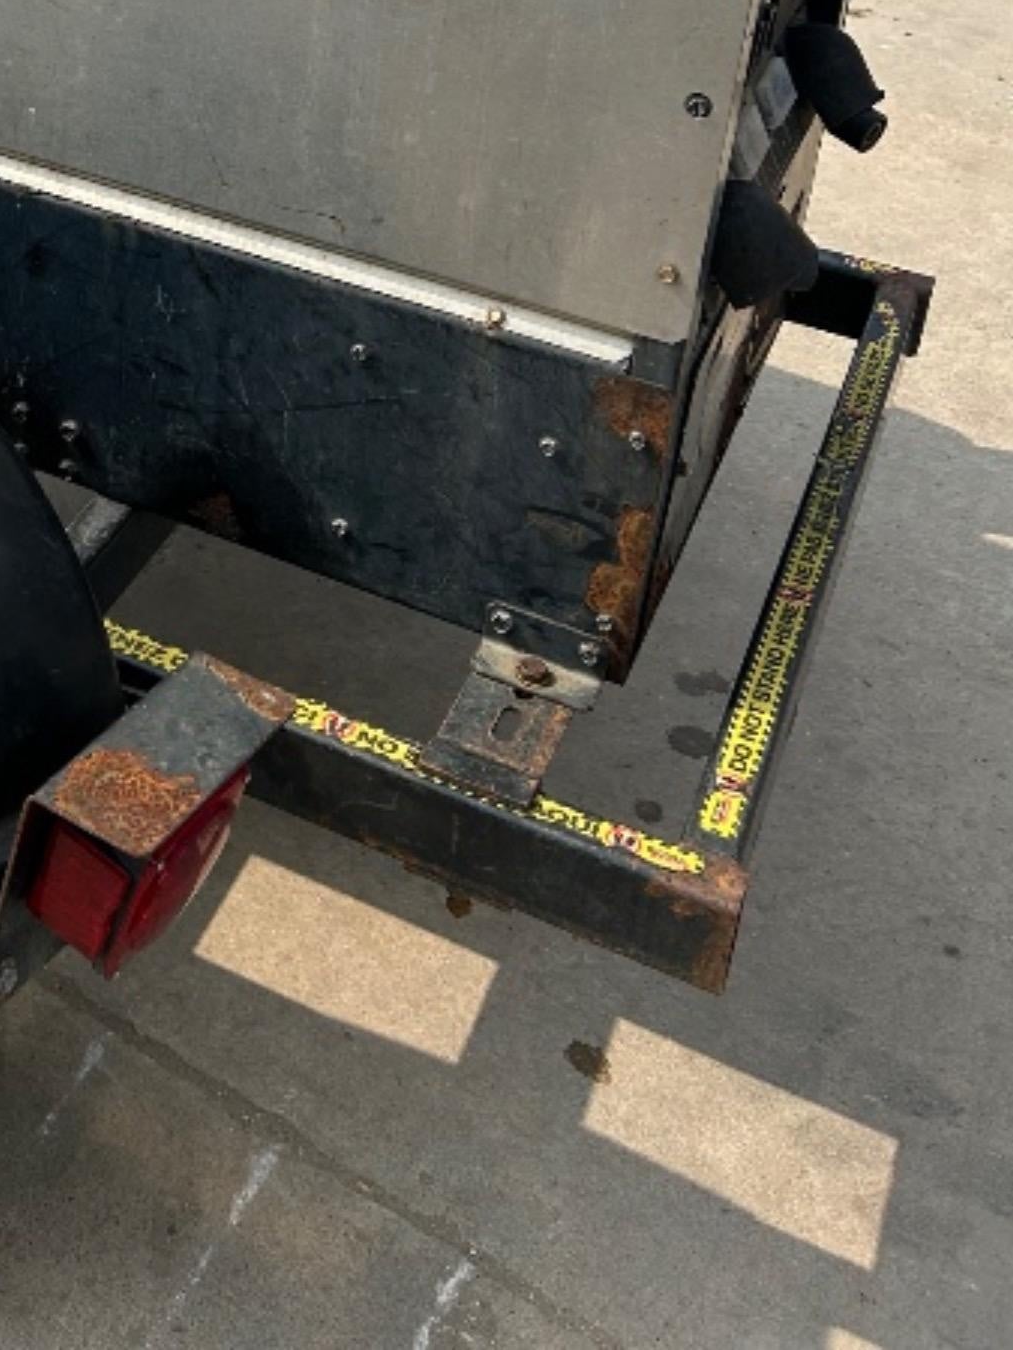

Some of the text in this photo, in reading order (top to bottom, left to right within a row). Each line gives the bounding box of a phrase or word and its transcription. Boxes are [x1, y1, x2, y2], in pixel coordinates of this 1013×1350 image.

[752, 648, 786, 703] STAND
[739, 707, 766, 742] NOT
[728, 742, 754, 773] DO
